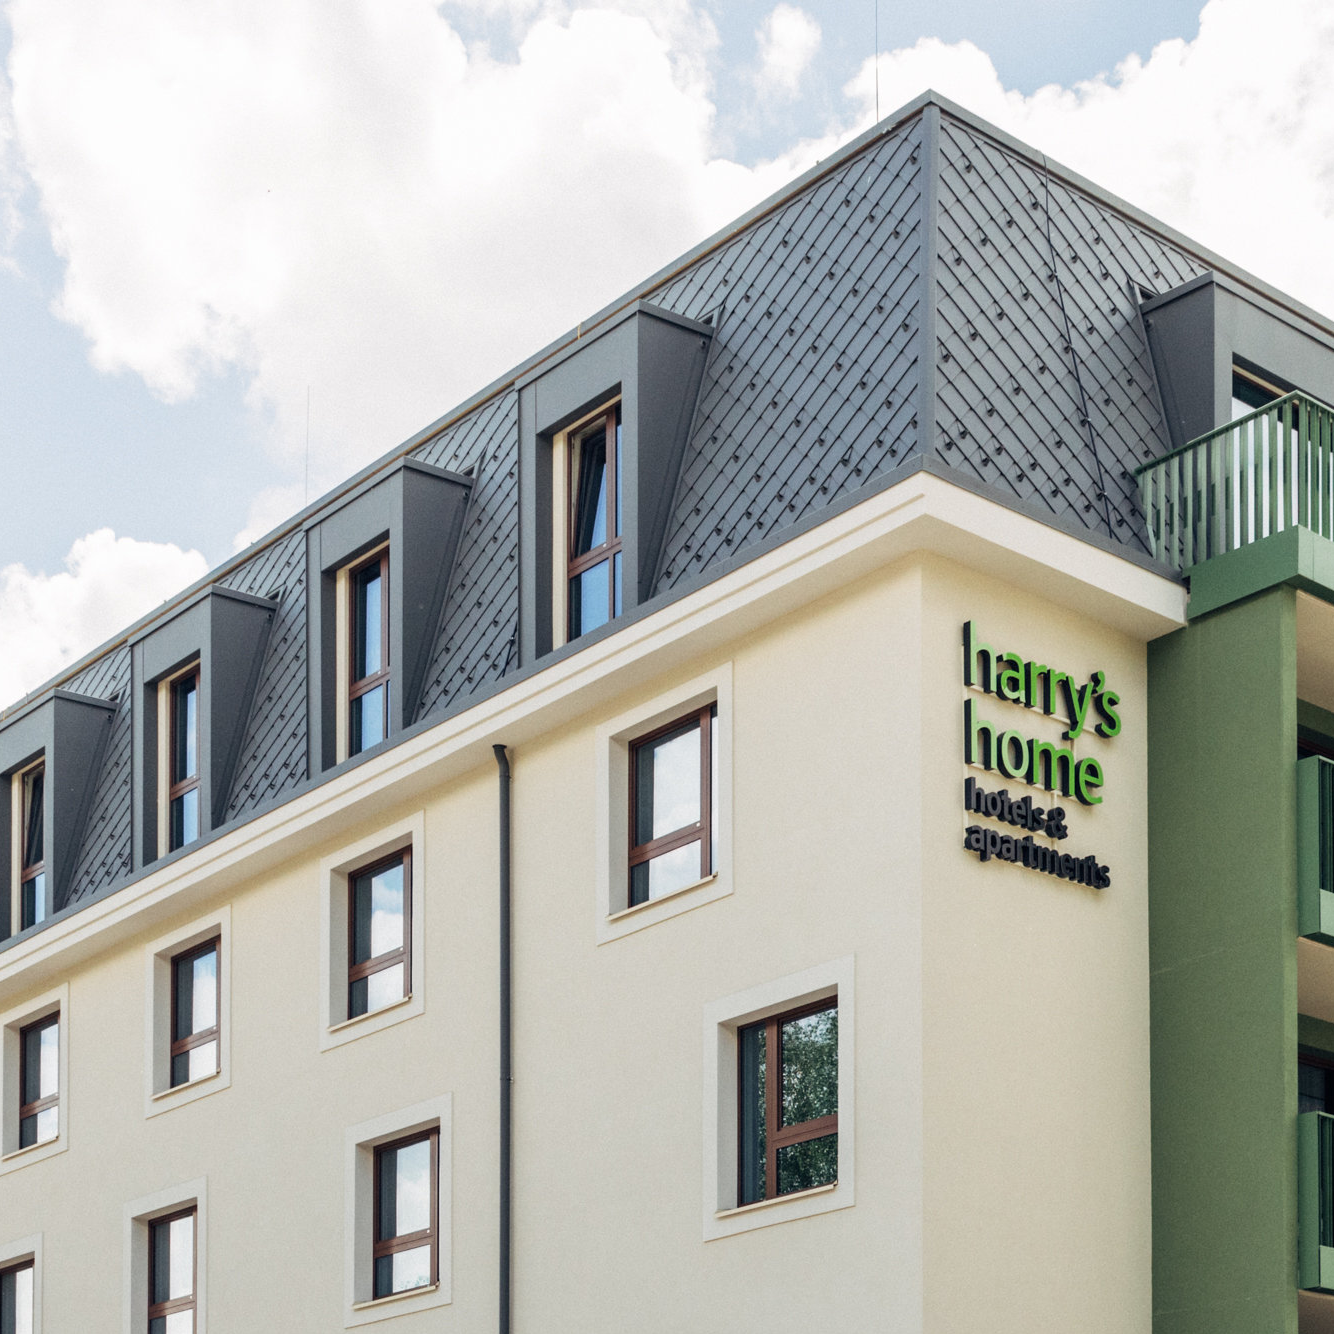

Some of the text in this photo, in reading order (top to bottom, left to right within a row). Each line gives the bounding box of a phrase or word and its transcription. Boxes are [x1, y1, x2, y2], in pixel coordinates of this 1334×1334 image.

[963, 620, 1122, 740] harry's
[964, 698, 1104, 806] home
[965, 777, 1069, 841] hotels &
[965, 824, 1111, 890] apartments
